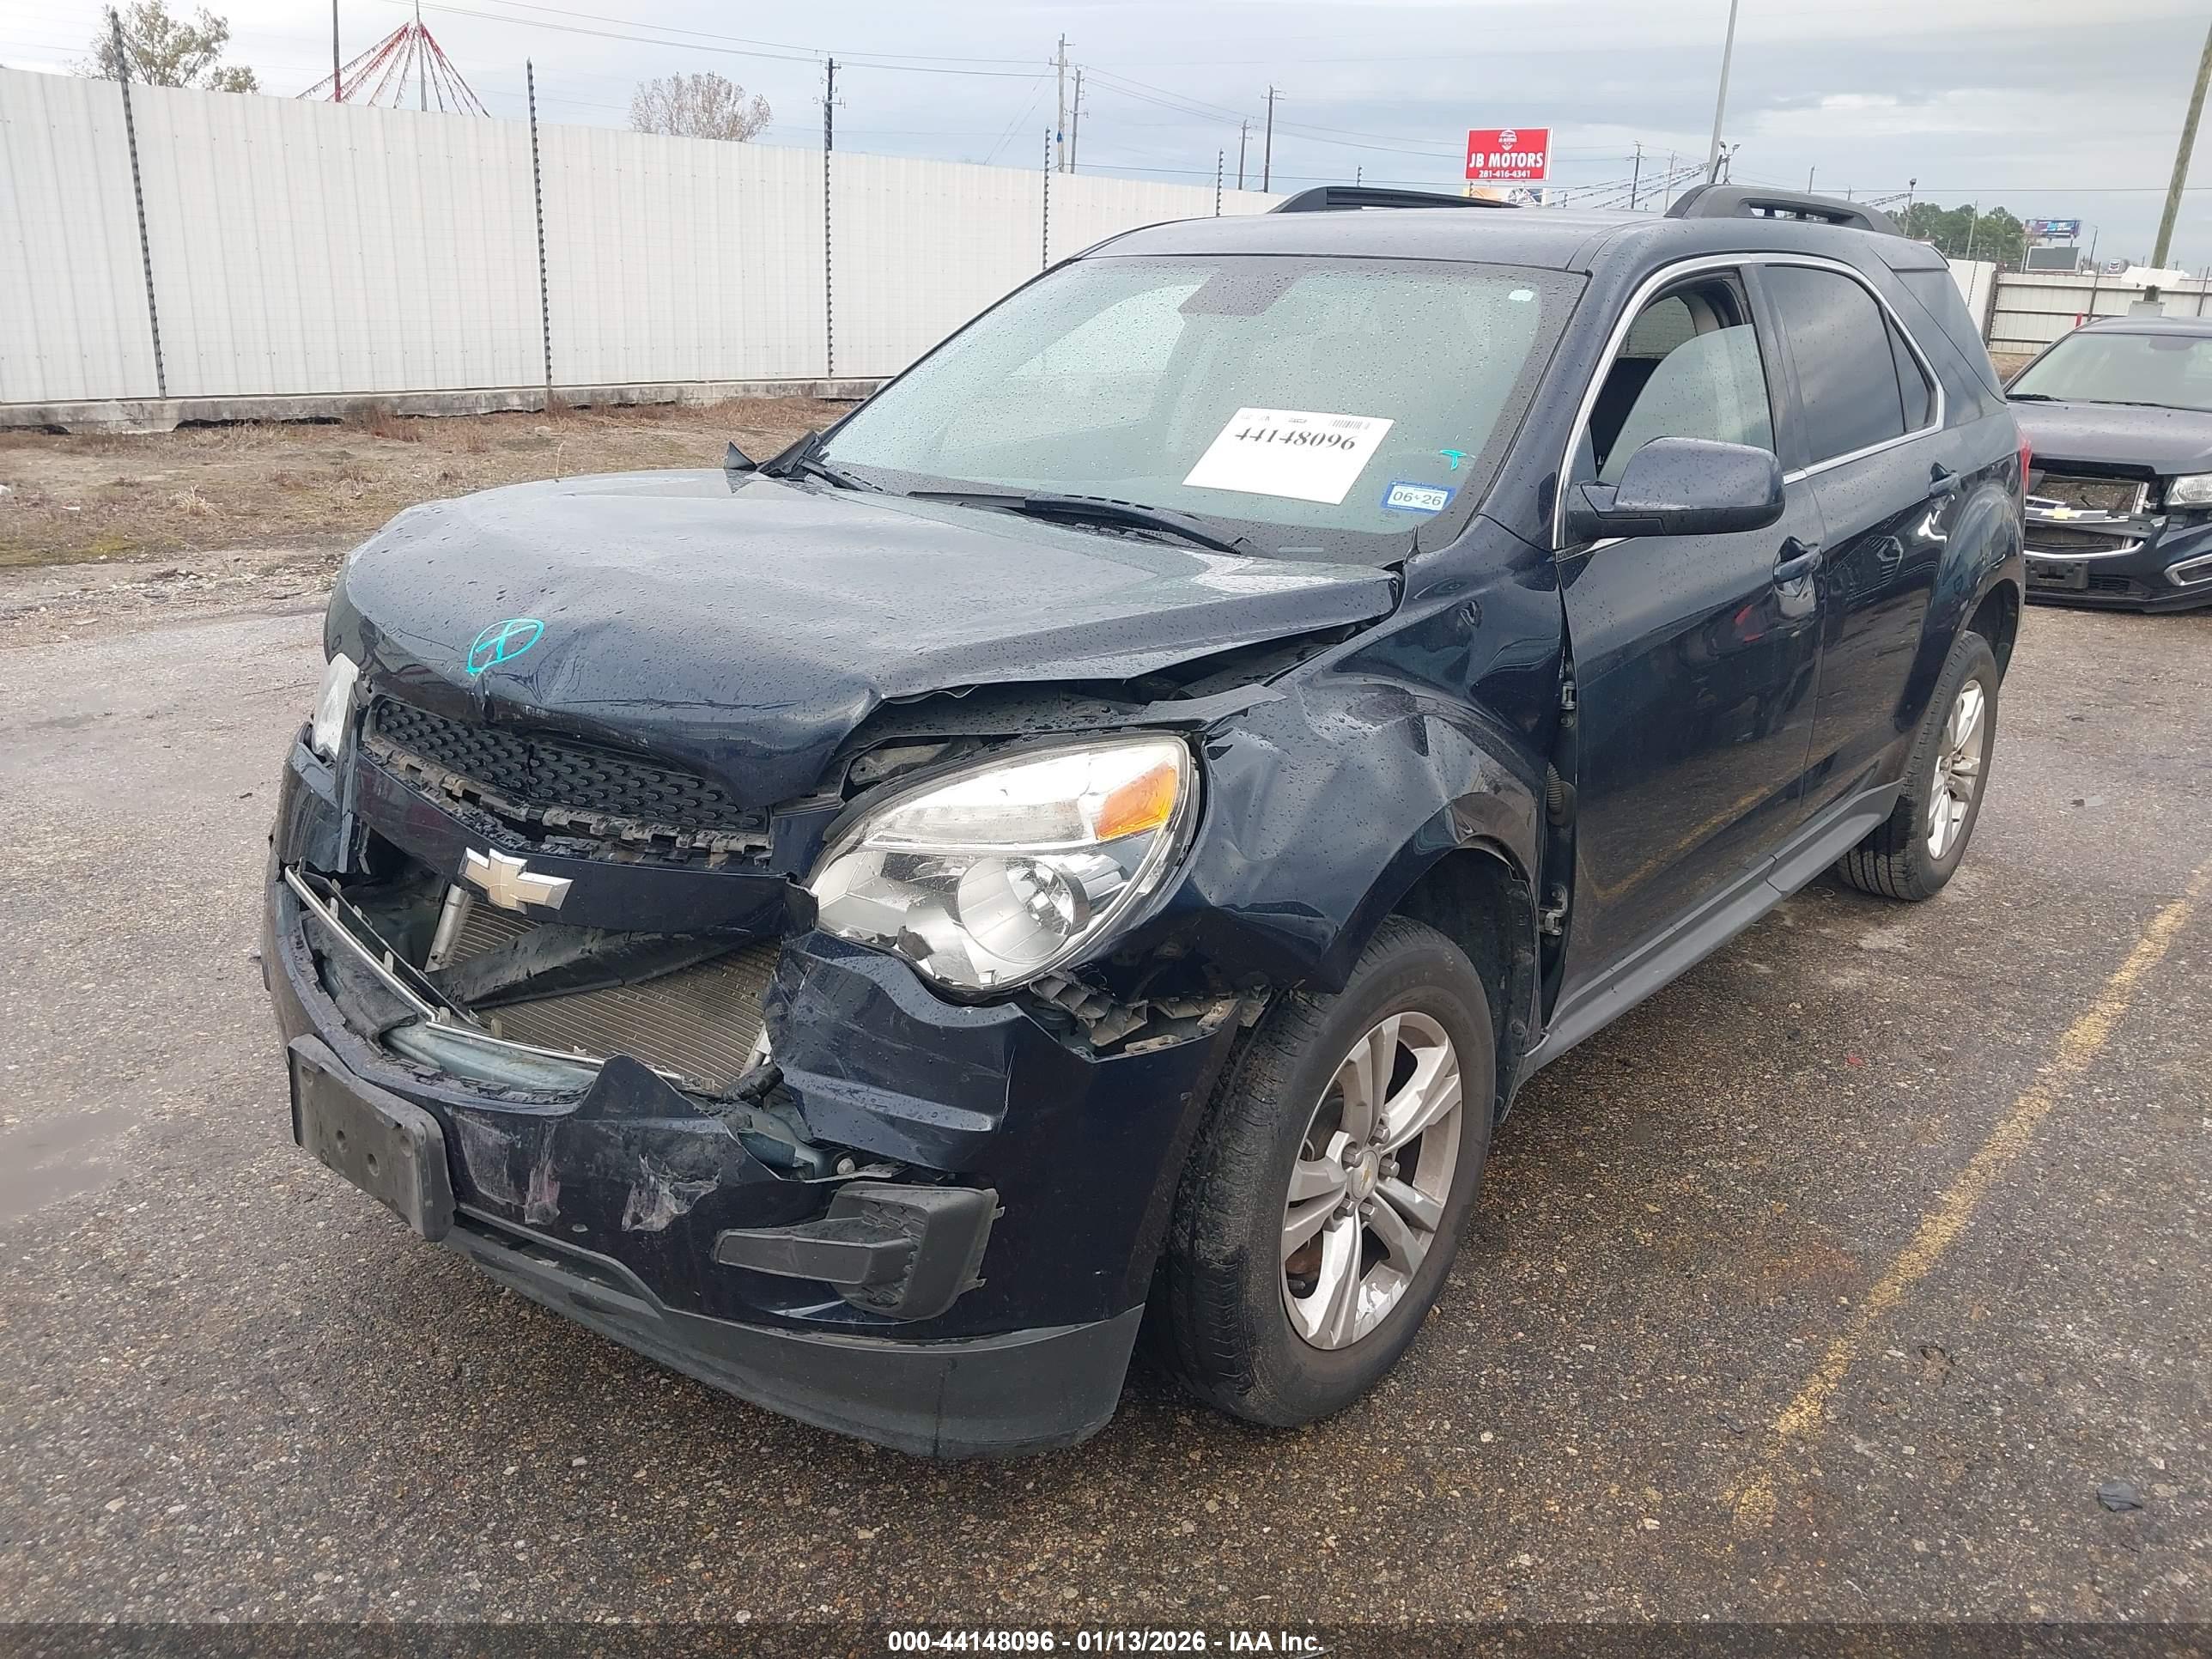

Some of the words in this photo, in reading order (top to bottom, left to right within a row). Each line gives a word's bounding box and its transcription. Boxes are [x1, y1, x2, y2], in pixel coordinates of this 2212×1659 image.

[1469, 153, 1485, 167] JB
[1488, 152, 1544, 167] MOTORS
[1235, 427, 1358, 451] 44148096
